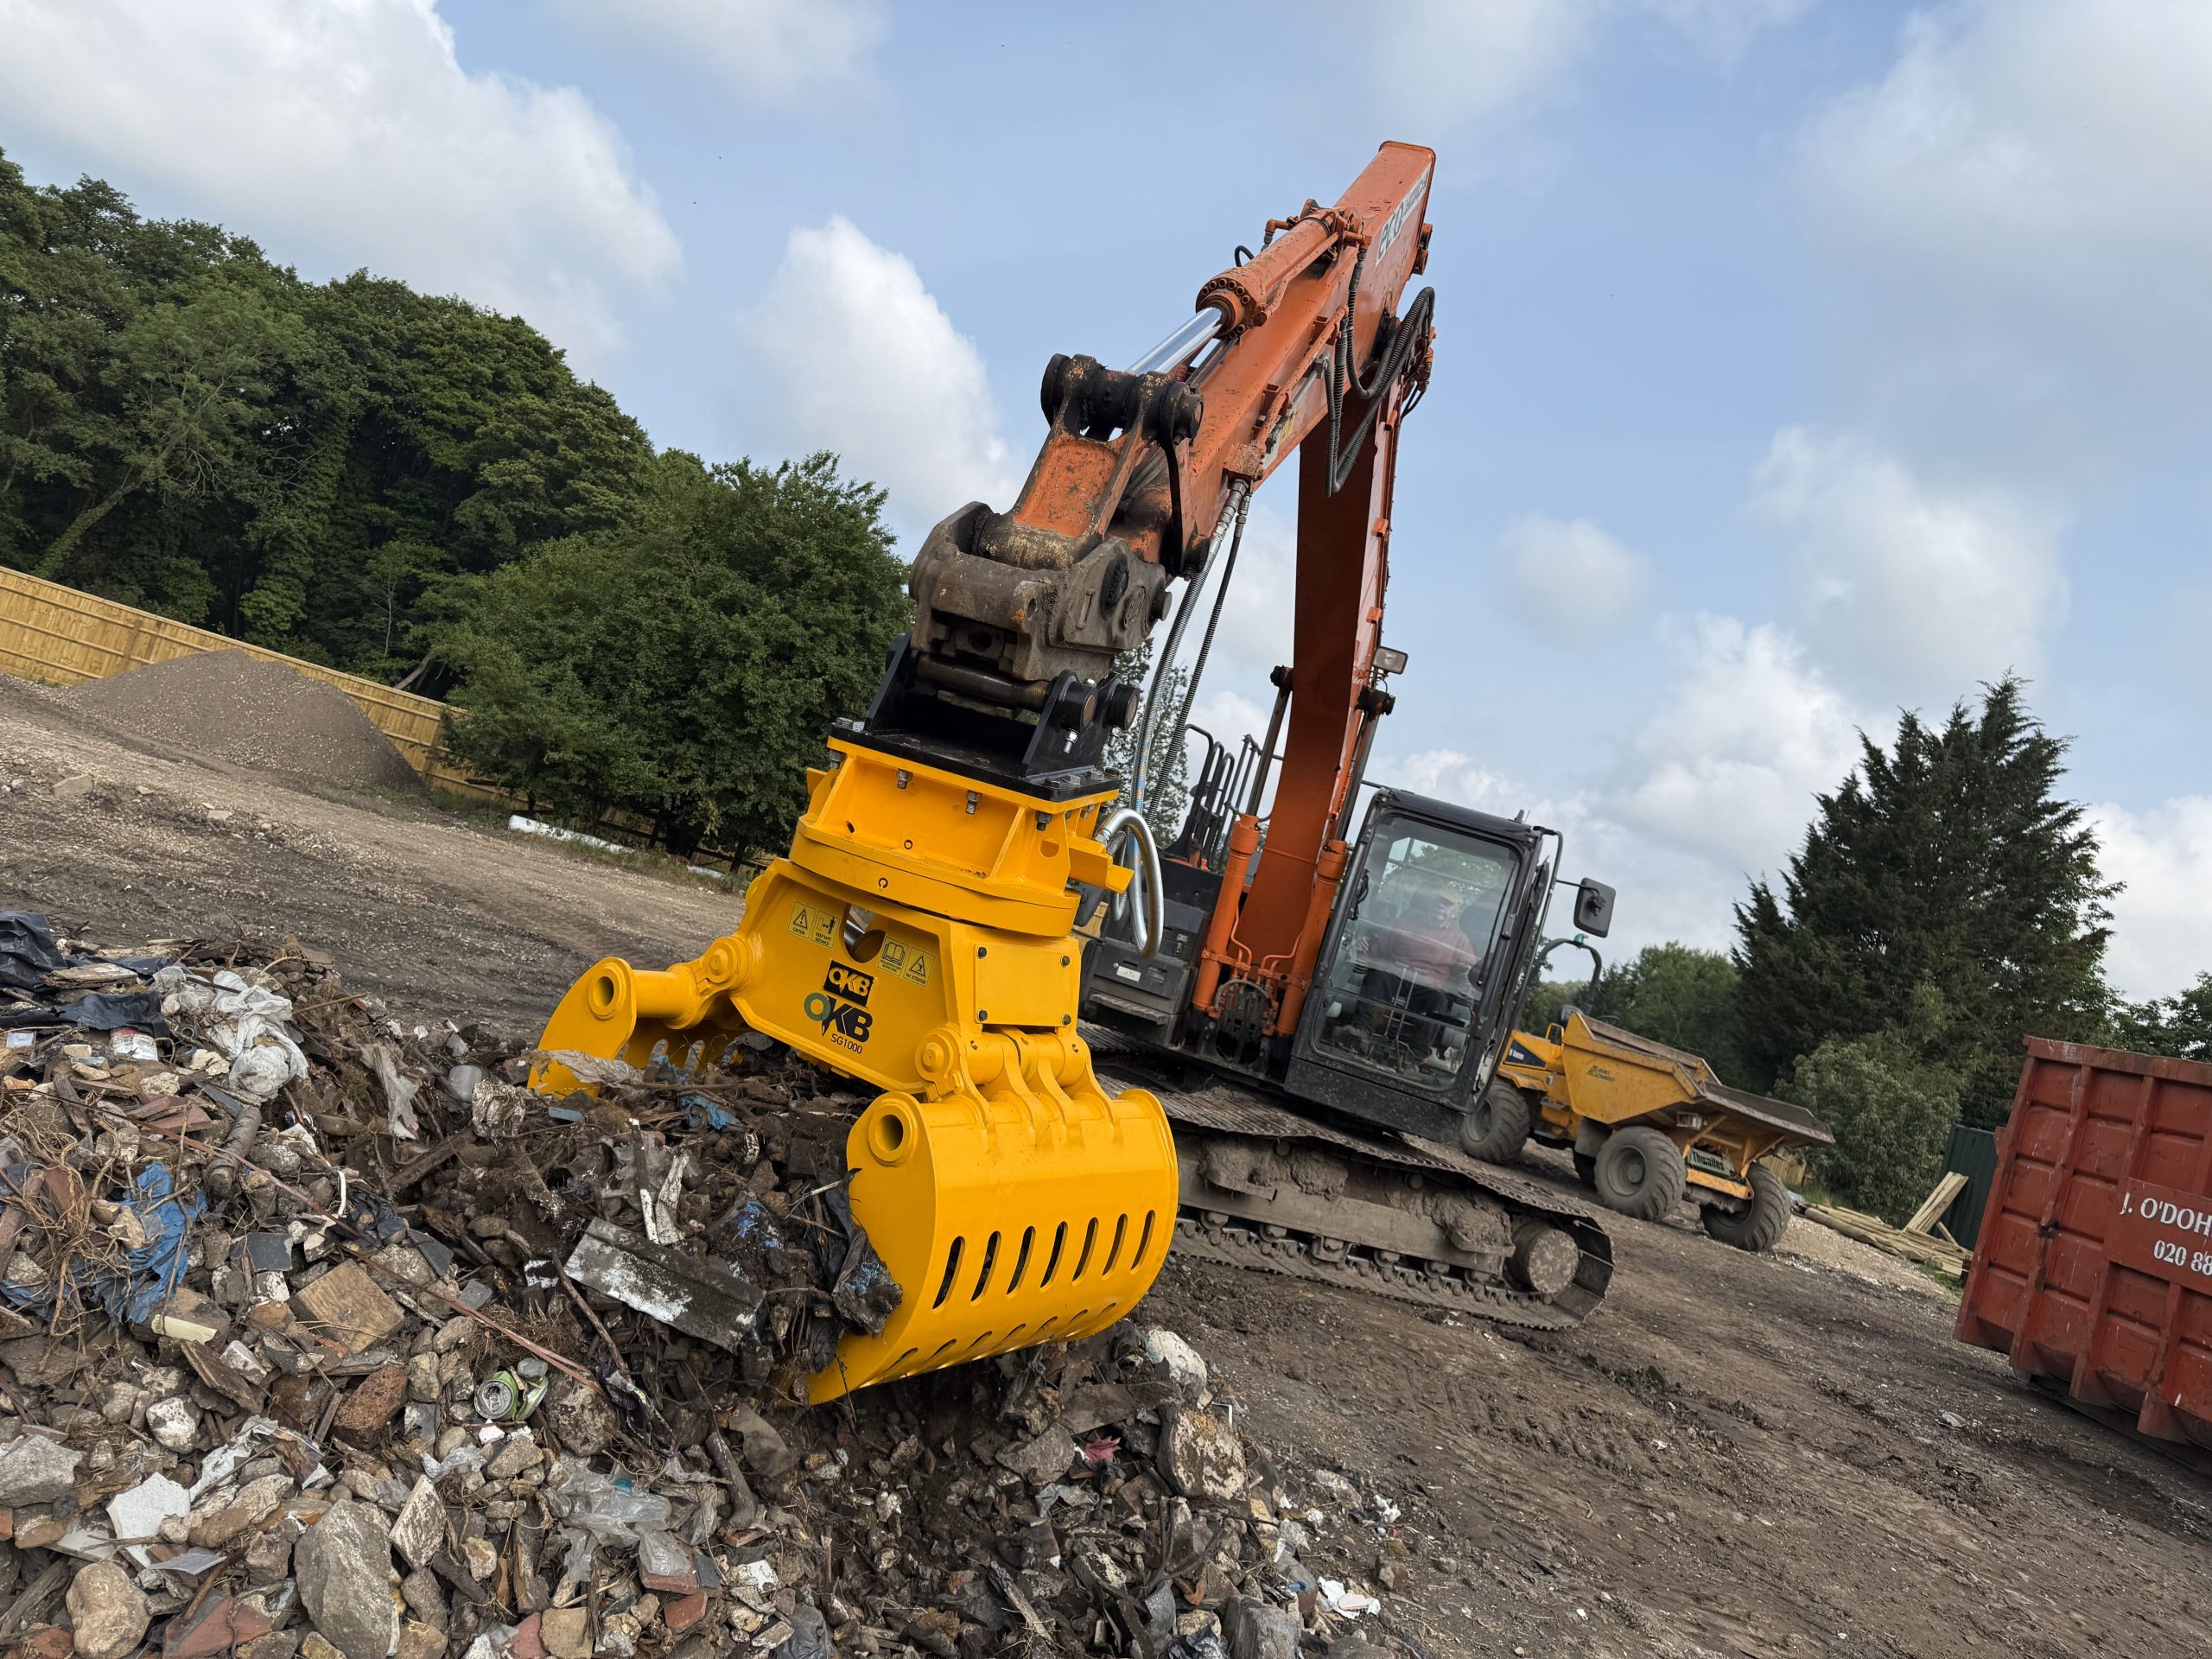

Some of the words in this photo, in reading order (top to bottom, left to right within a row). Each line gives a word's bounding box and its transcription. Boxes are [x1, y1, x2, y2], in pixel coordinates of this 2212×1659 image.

[829, 968, 871, 997] OKB
[804, 992, 874, 1043] OKB
[830, 1033, 863, 1054] SG1000
[2120, 1192, 2133, 1215] J.
[2140, 1198, 2212, 1236] O'DOH
[2153, 1240, 2187, 1267] 020
